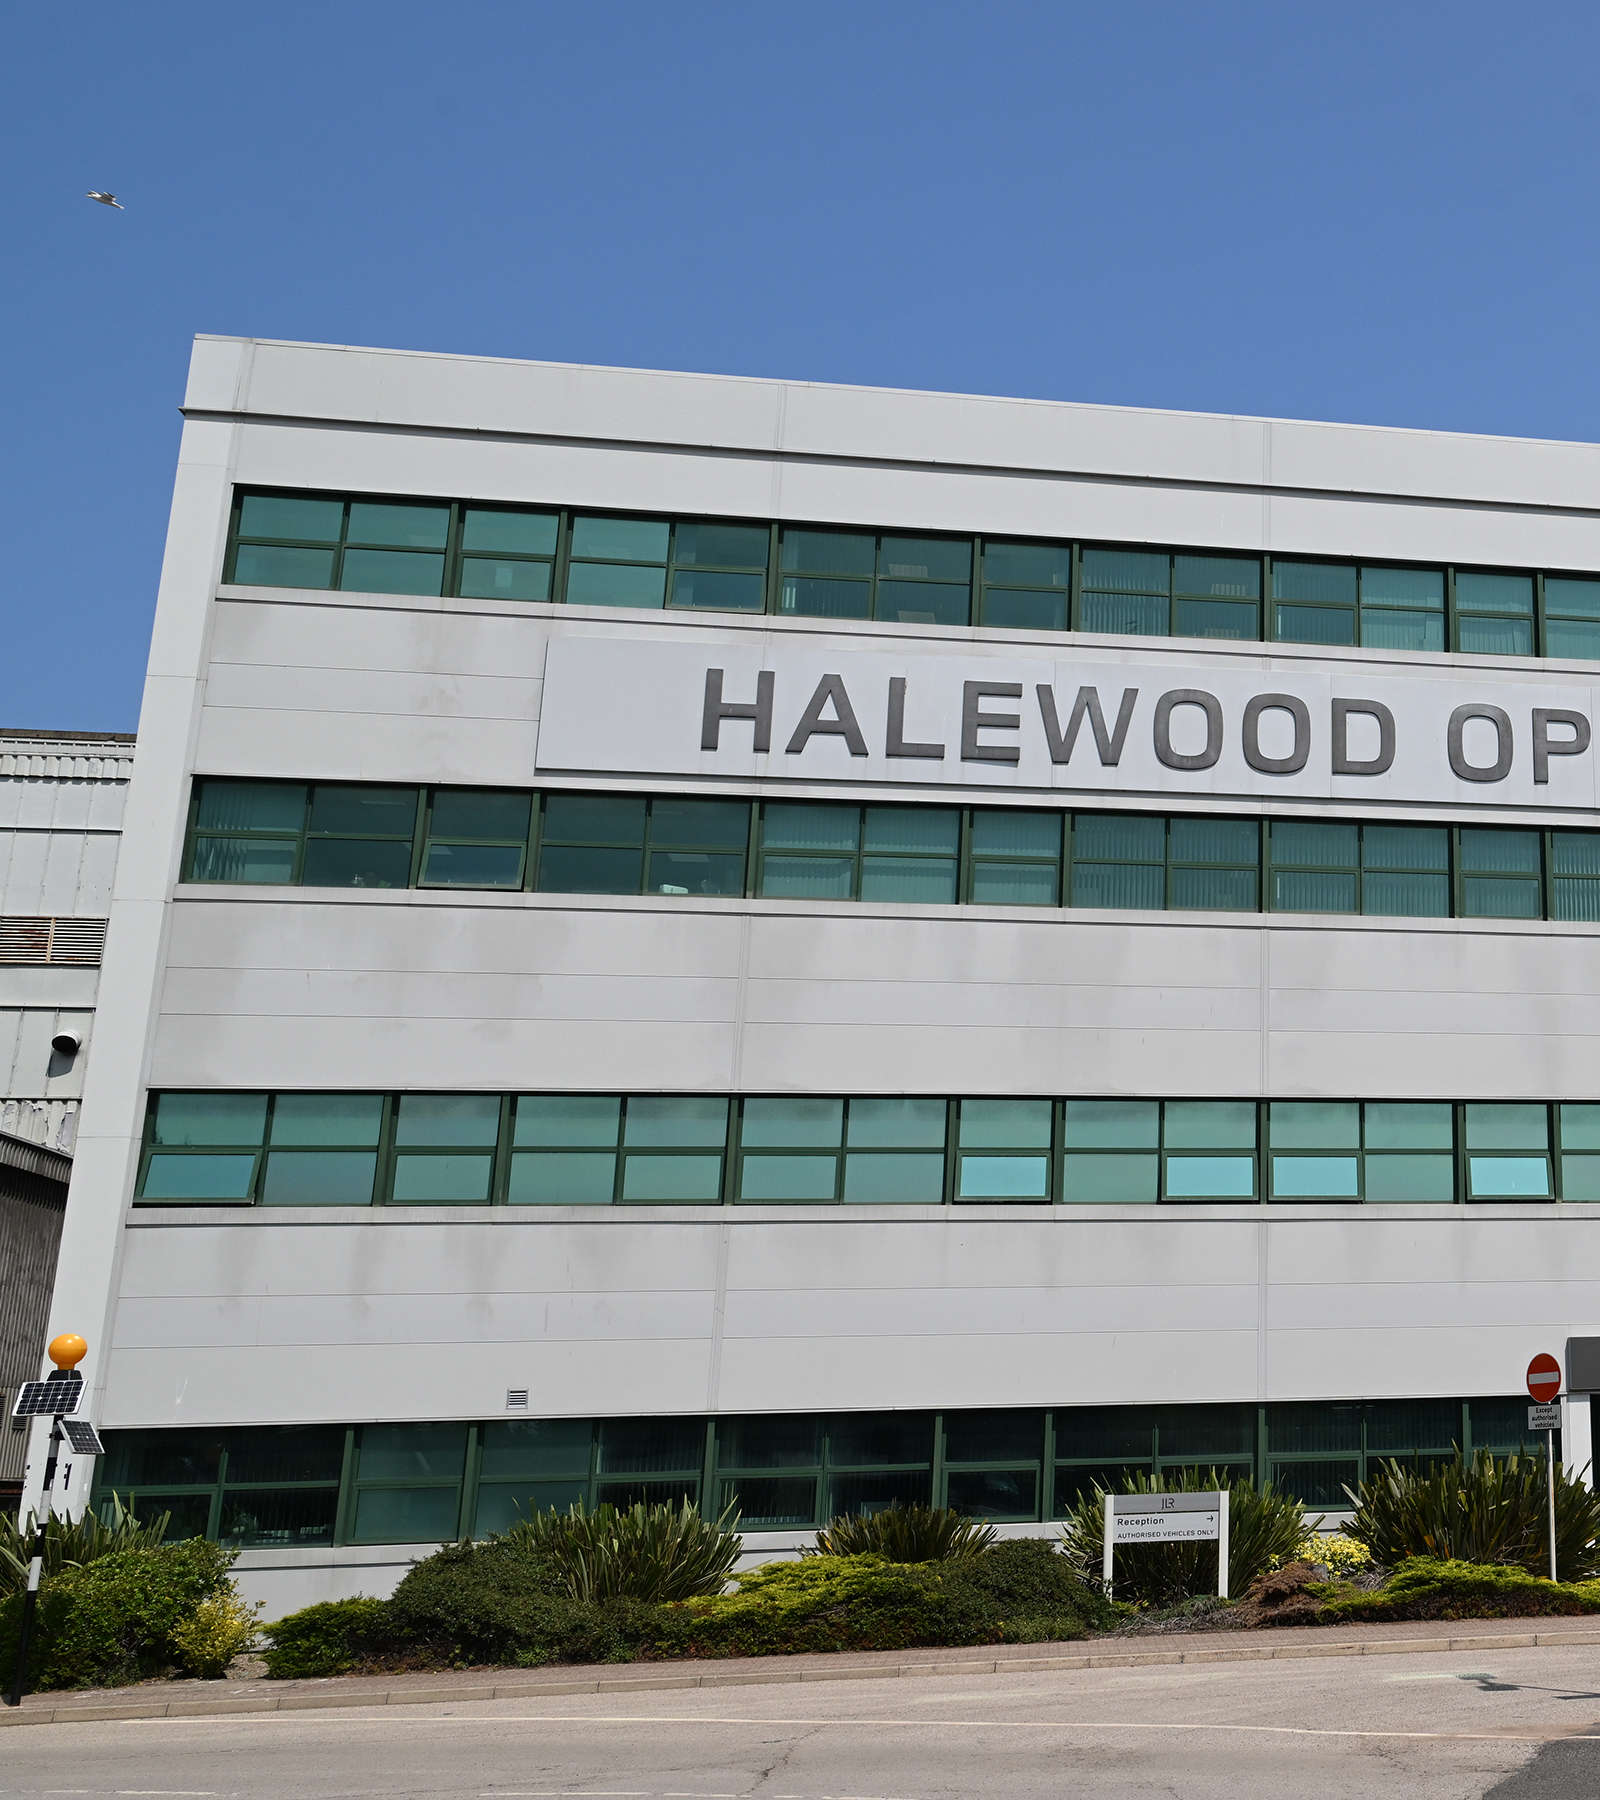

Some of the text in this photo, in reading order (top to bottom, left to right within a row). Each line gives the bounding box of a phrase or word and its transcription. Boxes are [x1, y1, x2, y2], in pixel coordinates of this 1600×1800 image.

[701, 667, 1396, 779] HALEWOOD
[1535, 1406, 1553, 1414] Except
[1531, 1414, 1558, 1422] authorised
[1534, 1421, 1555, 1429] vehicles
[1161, 1497, 1175, 1510] JLR
[1117, 1517, 1164, 1527] Reception
[1117, 1531, 1161, 1539] AUTHORISED
[1162, 1529, 1195, 1537] VEHICLES
